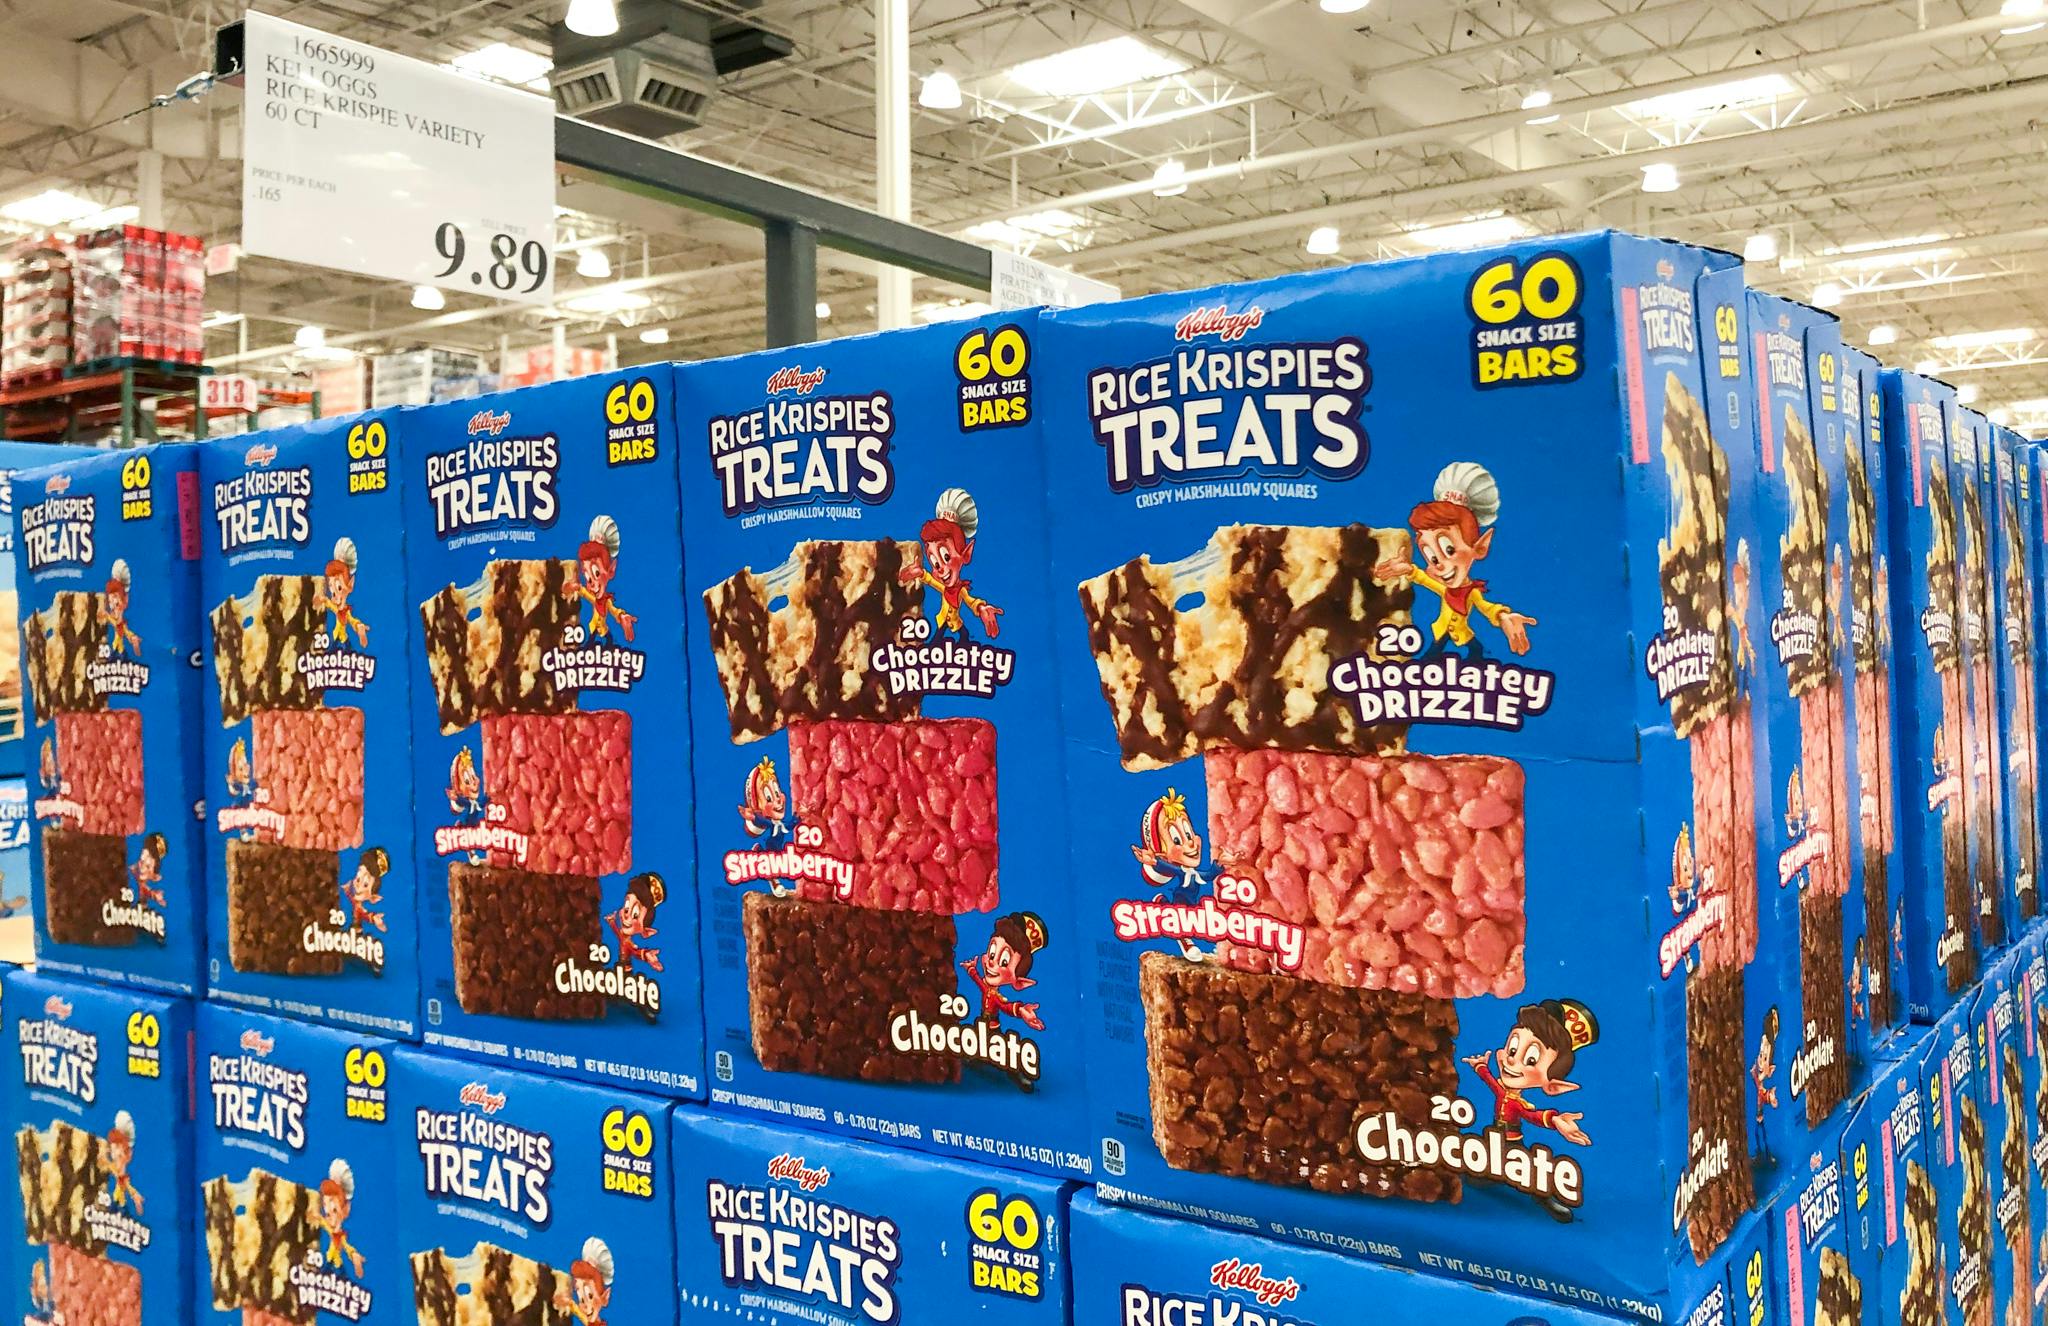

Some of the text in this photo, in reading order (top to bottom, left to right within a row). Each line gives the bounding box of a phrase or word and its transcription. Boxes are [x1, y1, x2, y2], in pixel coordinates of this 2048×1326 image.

[293, 36, 376, 74] 1665999
[265, 102, 322, 129] 60 CT
[266, 79, 486, 149] RICE KRISPIE VARIETY
[252, 186, 281, 202] .165
[308, 178, 337, 193] EACH
[434, 222, 548, 294] 9.89
[1471, 257, 1578, 324] 60
[1640, 283, 1691, 315] RICE KRISPIES
[1175, 305, 1264, 342] Kellogg's
[1477, 322, 1577, 348] SNACK SIZE
[1643, 309, 1693, 353] TREATS
[1715, 306, 1737, 343] 60
[958, 329, 1026, 381] 60
[1478, 345, 1577, 384] BARS
[1769, 353, 1803, 390] TREATS
[1819, 353, 1835, 383] 60
[206, 379, 246, 403] 313
[767, 365, 825, 394] Kellogg's
[962, 379, 1026, 400] SNACK SIZE
[1092, 343, 1364, 416] RICE KRISPIES
[606, 381, 655, 425] 60
[963, 396, 1027, 428] BARS
[468, 409, 511, 436] Kellogg's
[608, 423, 655, 440] SNACK SIZE
[711, 396, 890, 455] RICE KRISPIES
[1099, 394, 1361, 482] TREATS
[348, 422, 387, 460] 60
[609, 439, 655, 464] BARS
[121, 456, 151, 490] 60
[427, 437, 557, 487] RICE KRISPIES
[717, 436, 888, 508] TREATS
[214, 468, 311, 511] RICE KRISPIES
[350, 471, 386, 493] BARS
[1136, 482, 1318, 509] CRISPY MARSHMALLOW SQUARES
[22, 502, 44, 529] RICE
[45, 495, 95, 522] KRISPIES
[123, 500, 152, 521] BARS
[431, 471, 555, 532] TREATS
[767, 508, 825, 525] MARSHMALLOW
[217, 497, 309, 550] TREATS
[24, 521, 94, 569] TREATS
[1783, 589, 1794, 608] 20
[564, 626, 585, 644] 20
[902, 618, 930, 639] 20
[1662, 606, 1678, 630] 20
[1771, 612, 1818, 642] Chocolatey
[314, 633, 329, 649] 20
[1378, 626, 1422, 653] 20
[1647, 629, 1715, 674] Chocolatey
[1779, 636, 1813, 663] DRIZZLE
[297, 651, 375, 679] Chocolatey
[542, 646, 644, 678] Chocolatey
[555, 667, 630, 691] DRIZZLE
[872, 642, 1012, 680] Chocolatey
[1659, 658, 1710, 699] DRIZZLE
[307, 670, 364, 691] DRIZZLE
[889, 667, 994, 695] DRIZZLE
[1332, 658, 1550, 708] Chocolatey
[1360, 691, 1523, 725] DRIZZLE
[487, 804, 506, 821] 20
[435, 823, 528, 863] Strawberry
[798, 825, 823, 845] 20
[724, 846, 854, 897] Strawberry
[1219, 876, 1257, 903] 20
[1703, 867, 1715, 887] 20
[330, 909, 346, 926] 20
[1112, 900, 1303, 968] Strawberry
[303, 922, 384, 966] Chocolate
[589, 944, 610, 963] 20
[1659, 894, 1726, 979] Strawberry
[555, 958, 659, 1010] Chocolate
[940, 994, 968, 1018] 20
[127, 1011, 160, 1047] 60
[891, 1010, 1039, 1076] Chocolate
[1564, 1009, 1589, 1044] POP
[1807, 1020, 1816, 1042] 20
[21, 1044, 96, 1103] TREATS
[210, 1055, 307, 1104] RICE KRISPIES
[345, 1048, 386, 1088] 60
[1790, 1035, 1835, 1098] Chocolate
[460, 1082, 507, 1114] Kellogg's
[1931, 1073, 1940, 1103] 60
[212, 1083, 305, 1149] TREATS
[712, 1088, 983, 1151] CRISPY BARS NET WT 46.5
[1431, 1095, 1474, 1125] 20
[417, 1110, 551, 1171] RICE KRISPIES
[602, 1110, 652, 1158] 60
[1692, 1127, 1704, 1156] 20
[1894, 1107, 1921, 1153] TREATS
[604, 1153, 652, 1173] SNACK SIZE
[1107, 1140, 1120, 1158] 90
[1356, 1112, 1578, 1200] Chocolate
[1854, 1143, 1867, 1179] 60
[420, 1142, 549, 1223] TREATS
[604, 1168, 652, 1197] BARS
[768, 1153, 829, 1190] Kellogg's
[1673, 1138, 1729, 1232] Chocolate
[1800, 1187, 1814, 1215] RICE
[1803, 1184, 1840, 1243] TREATS
[709, 1183, 897, 1261] RICE KRISPIES
[968, 1193, 1039, 1250] 60
[972, 1243, 1039, 1269] SNACK SIZE
[1096, 1181, 1604, 1308] CRISPY SQUARES 60 0.78 OZ (22g) BARS NET WT 46.5 OZ LB 14.5 OZ)
[715, 1221, 893, 1322] TREATS
[973, 1264, 1039, 1297] BARS
[1211, 1257, 1300, 1305] Kellogg's
[1747, 1251, 1762, 1298] 60
